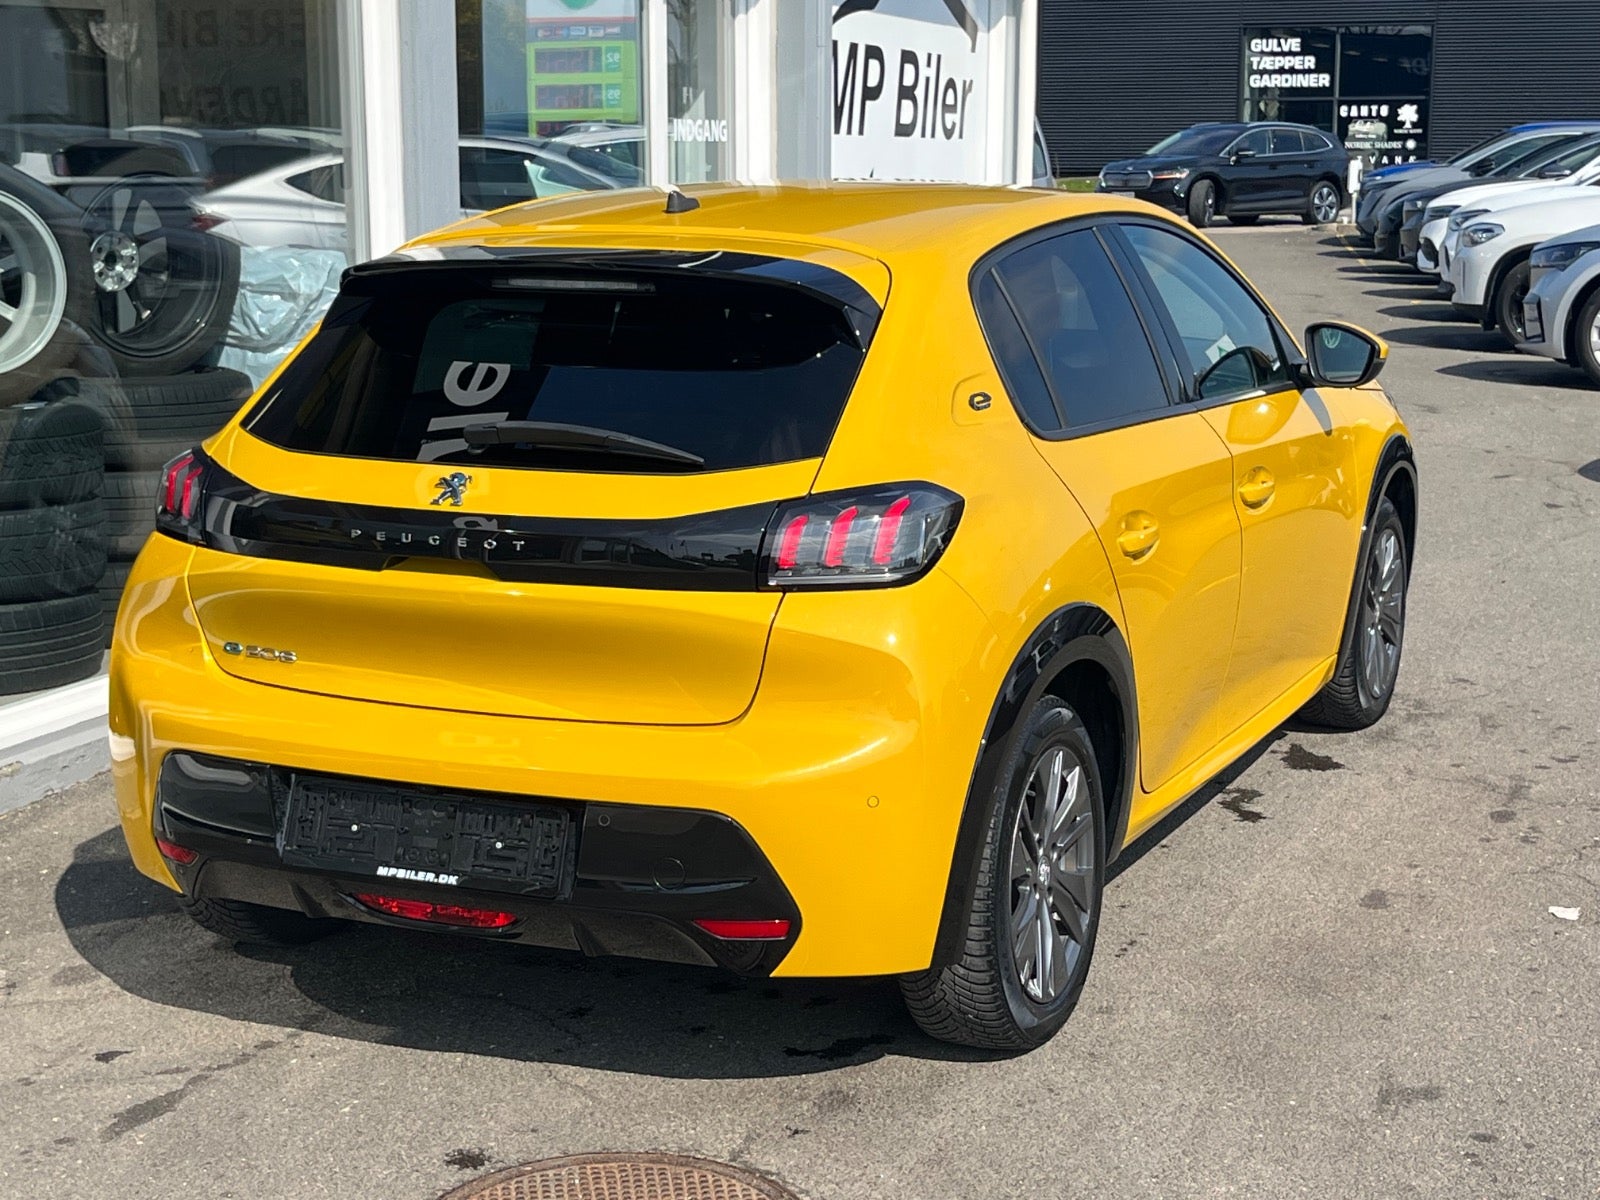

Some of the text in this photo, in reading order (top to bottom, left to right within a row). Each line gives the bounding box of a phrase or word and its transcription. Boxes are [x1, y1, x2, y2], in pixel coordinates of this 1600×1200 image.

[1250, 38, 1301, 52] GULVE
[1250, 55, 1316, 70] TÆPPER
[832, 39, 973, 141] MP Biler
[1249, 73, 1331, 88] GARDINER
[673, 118, 728, 142] INDGANG
[350, 528, 526, 551] PEUGEOT
[376, 865, 460, 885] MPBILER.DK
